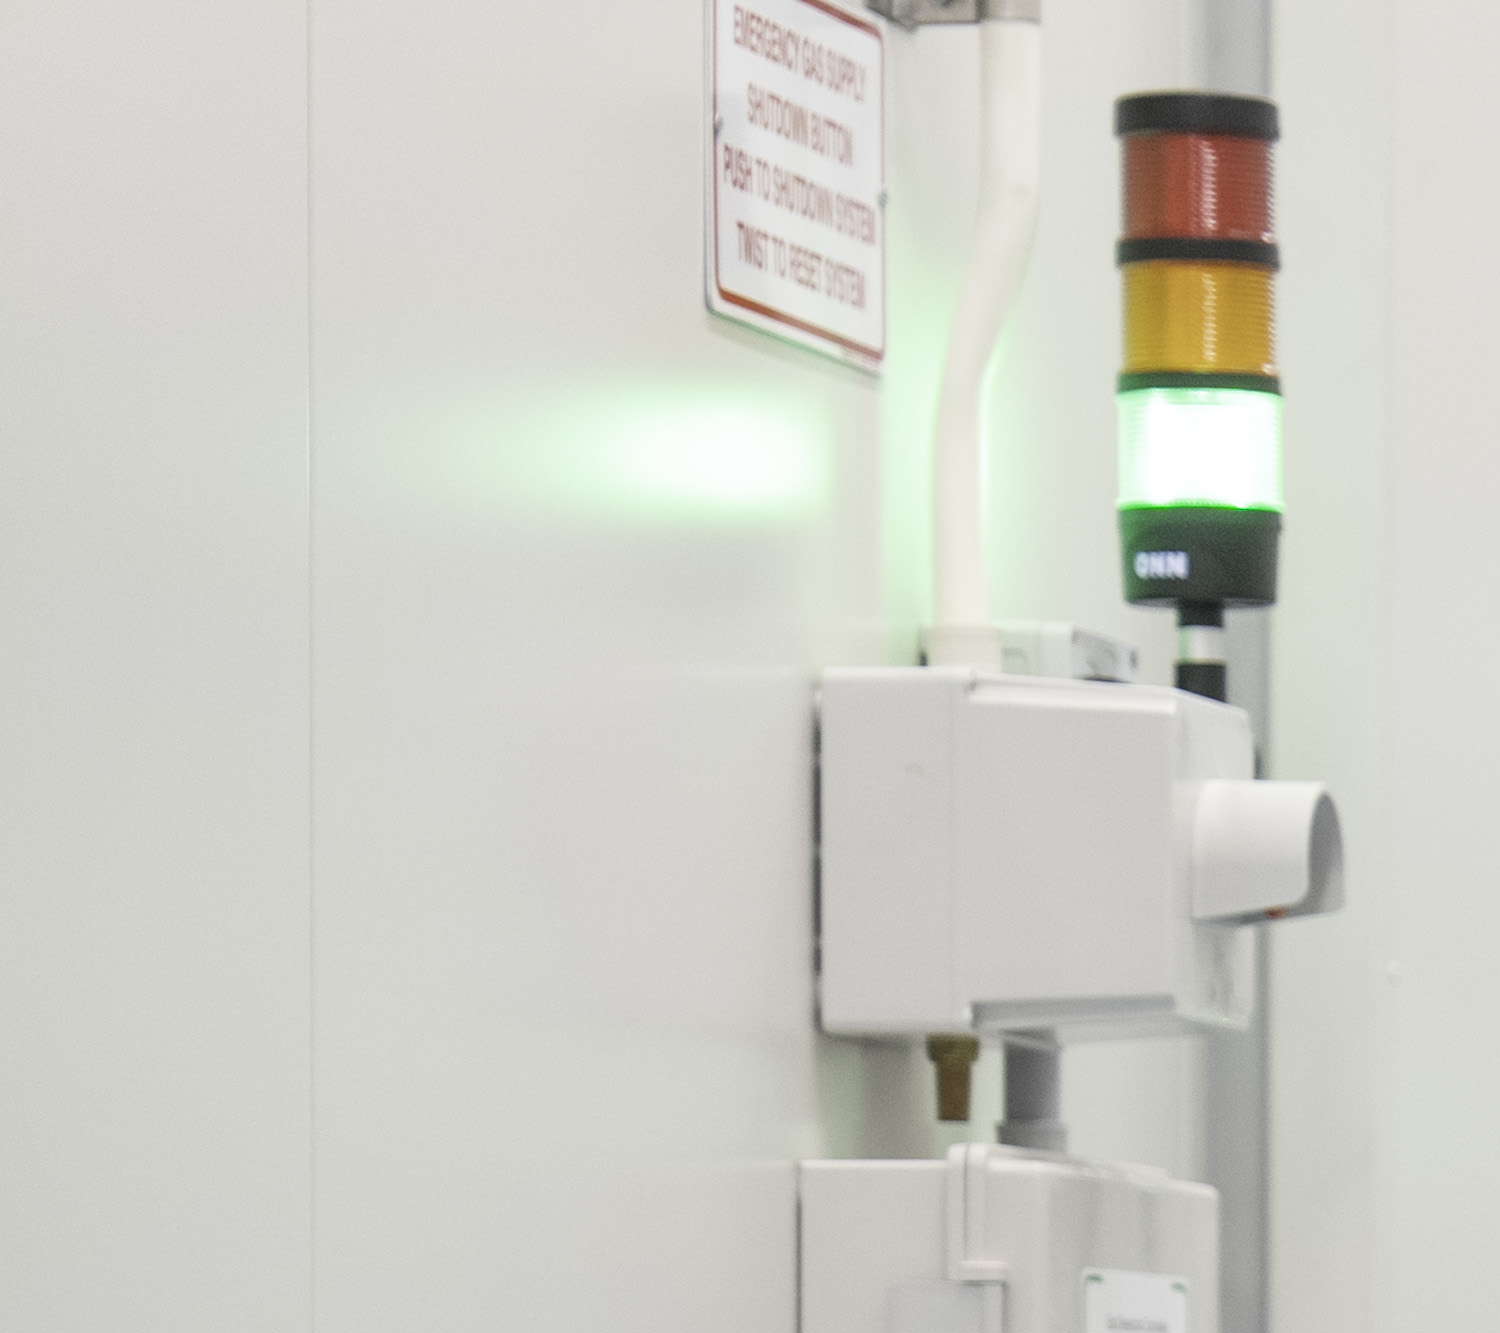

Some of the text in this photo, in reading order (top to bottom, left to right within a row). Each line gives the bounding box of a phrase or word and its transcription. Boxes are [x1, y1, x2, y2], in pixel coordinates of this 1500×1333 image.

[734, 4, 865, 102] EMERGENCY GAS SUPPLY
[747, 82, 852, 168] SHUTDOWN BUTTON
[724, 143, 875, 245] PUSH TO SHUTDOWN SYSTEM
[736, 220, 866, 311] TWIST TO RESET SYSTEM
